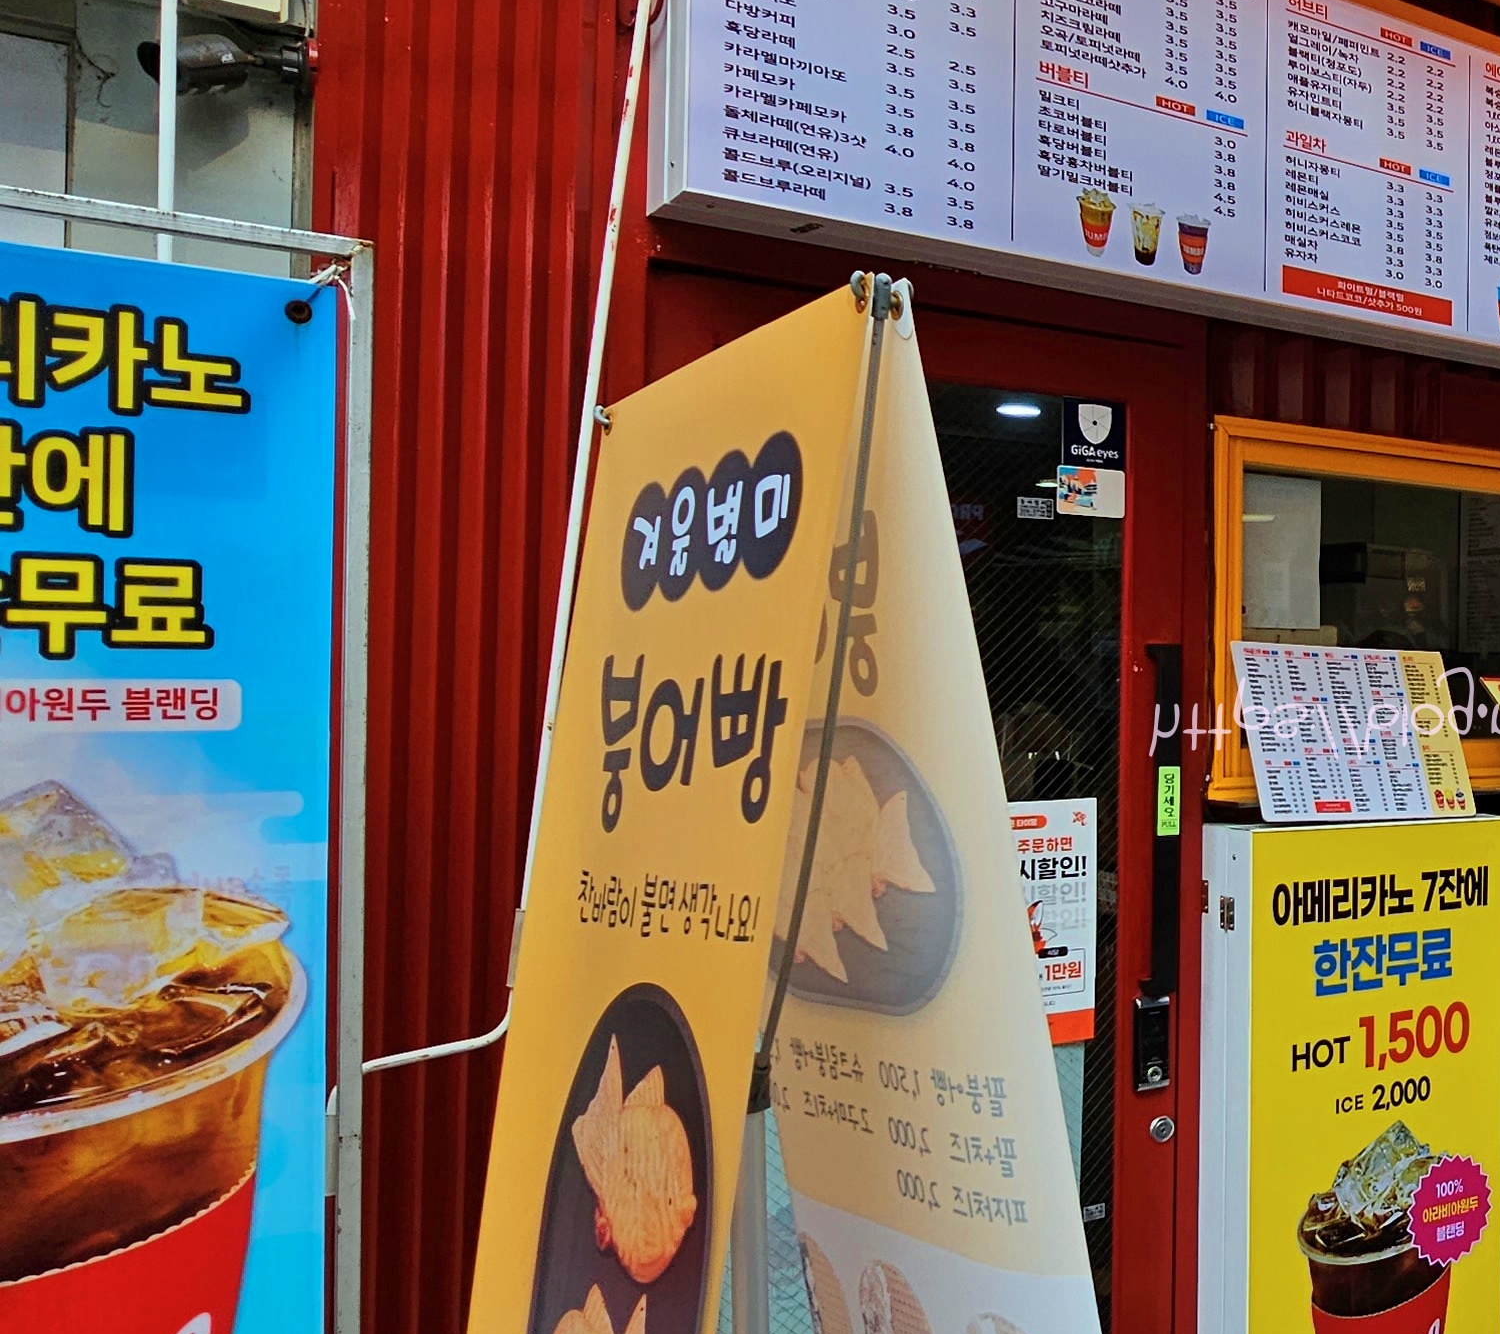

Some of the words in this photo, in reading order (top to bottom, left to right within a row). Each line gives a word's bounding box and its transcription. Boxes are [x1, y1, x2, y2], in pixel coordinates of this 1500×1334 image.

[725, 0, 796, 28] 다방커피
[724, 42, 847, 83] 카라멜마끼아또
[724, 63, 797, 90] 카페모카
[1040, 61, 1089, 89] 버블티
[1285, 130, 1326, 153] 과일차
[722, 168, 826, 201] 콜드브루라떼
[1097, 449, 1118, 459] eyes
[121, 686, 220, 722] 블랜딩
[601, 652, 788, 834] 붕어빵
[1163, 774, 1175, 817] 당기세요
[1017, 837, 1073, 854] 주문하면
[578, 869, 637, 930] 찬바람이
[640, 872, 677, 939] 불면
[1272, 875, 1414, 929] 아메리카노
[1421, 866, 1490, 911] 7잔에
[1044, 961, 1082, 982] 1만원
[1313, 928, 1452, 997] 한잔무료
[1291, 1036, 1351, 1073] HOT
[1358, 1001, 1470, 1071] 1,500
[1335, 1094, 1364, 1115] ICE
[1372, 1076, 1432, 1112] 2,000
[1436, 1178, 1464, 1199] 100%
[1422, 1196, 1479, 1223] 아라비아원두
[1437, 1221, 1465, 1242] 블랜딩
